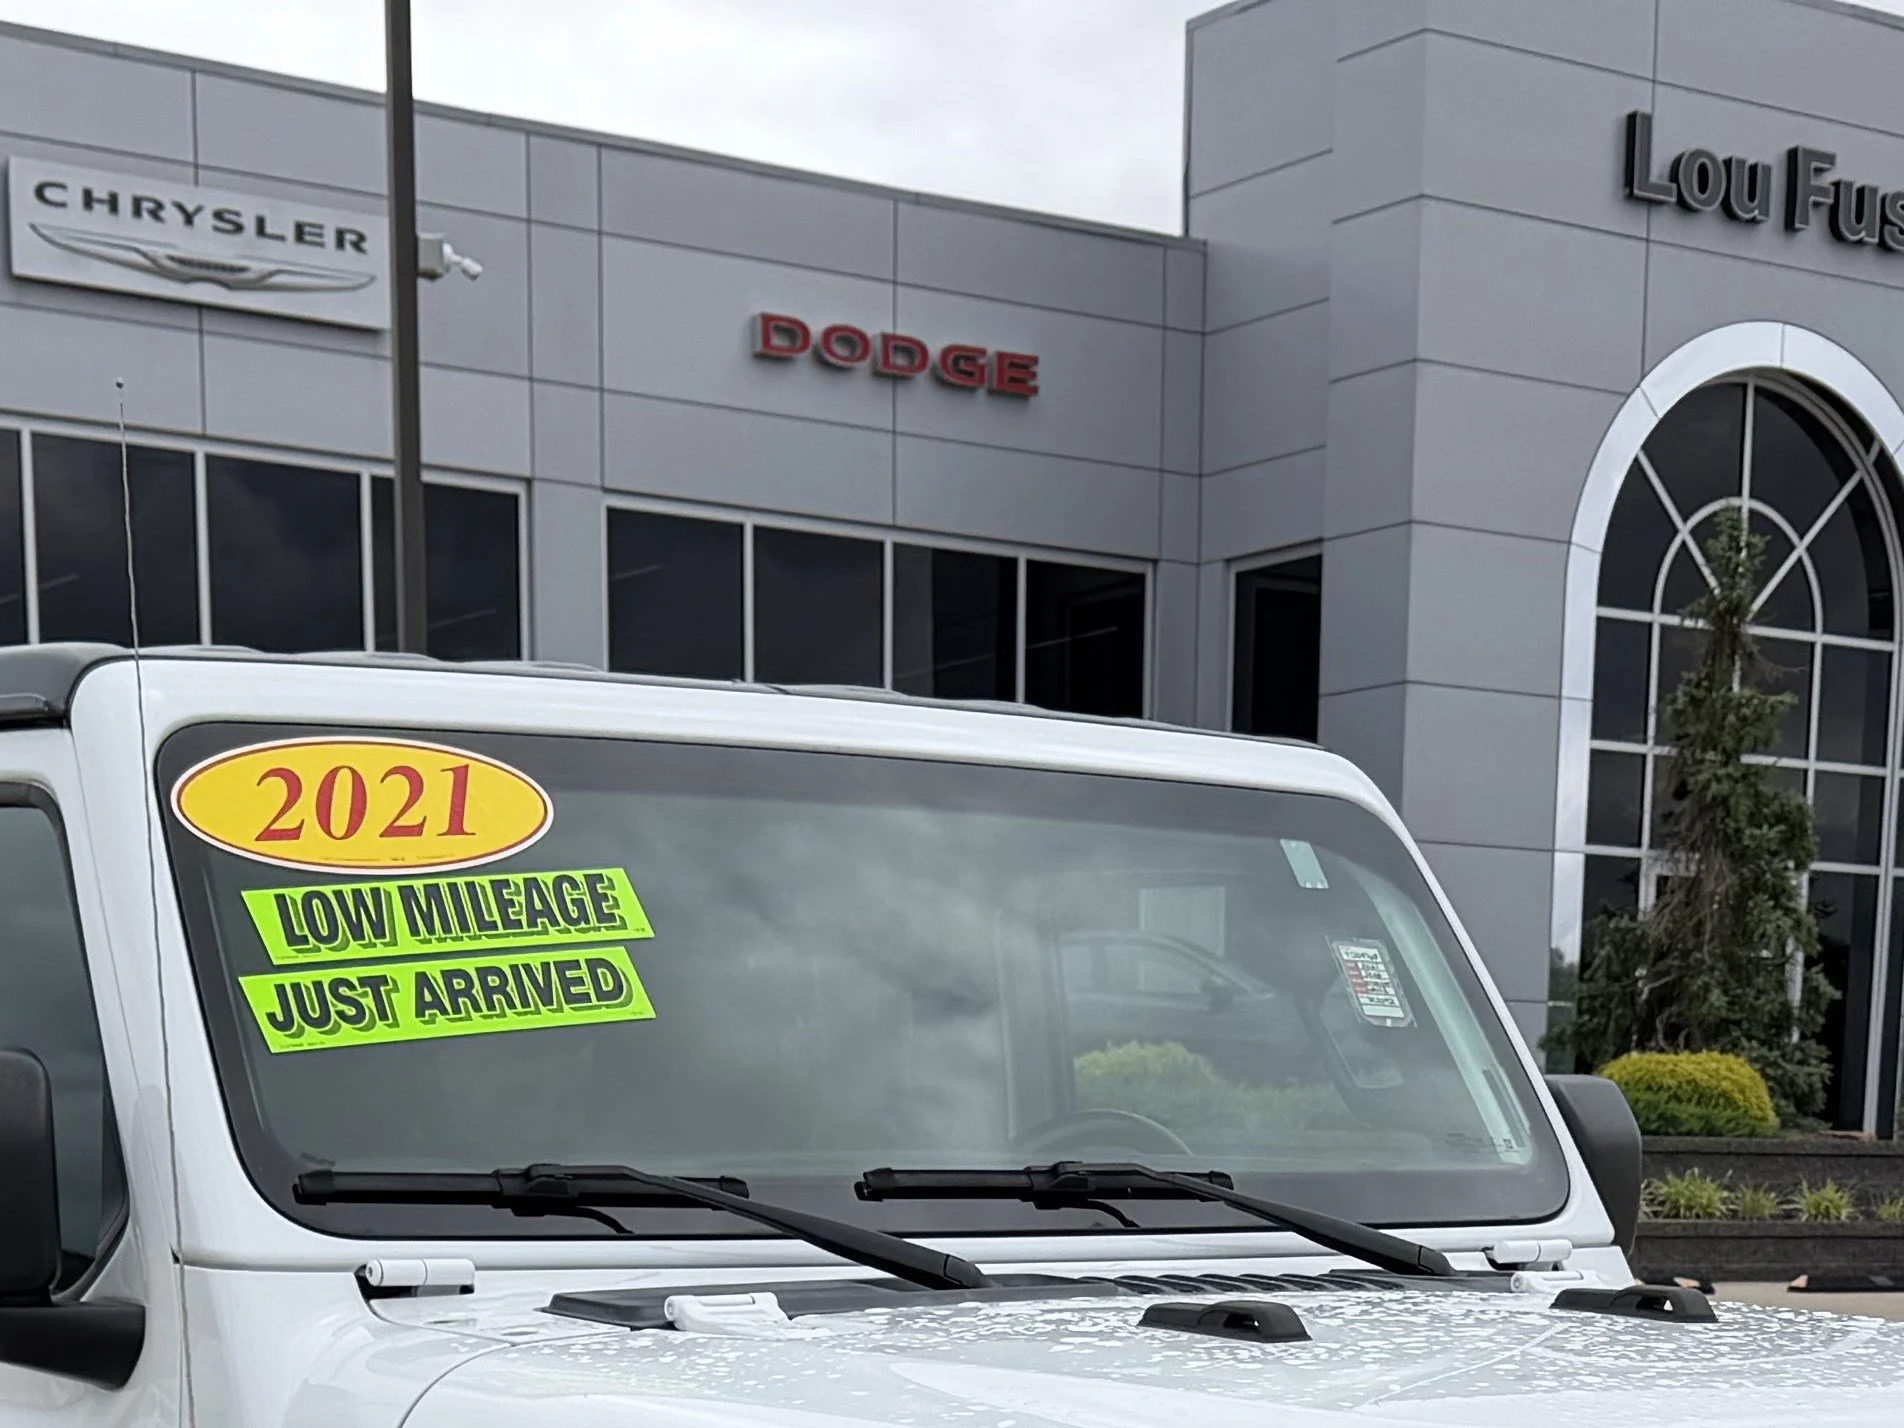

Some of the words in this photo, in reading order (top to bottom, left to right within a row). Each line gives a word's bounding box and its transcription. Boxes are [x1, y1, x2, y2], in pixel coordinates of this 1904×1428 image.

[1624, 110, 1772, 223] Lou
[33, 180, 369, 255] CHRYSLER
[754, 310, 1041, 398] DODGE
[254, 763, 477, 843] 2021
[274, 886, 398, 954] LOW
[397, 872, 628, 944] MILEAGE
[265, 974, 400, 1039] JUST
[415, 956, 635, 1025] ARRIVED
